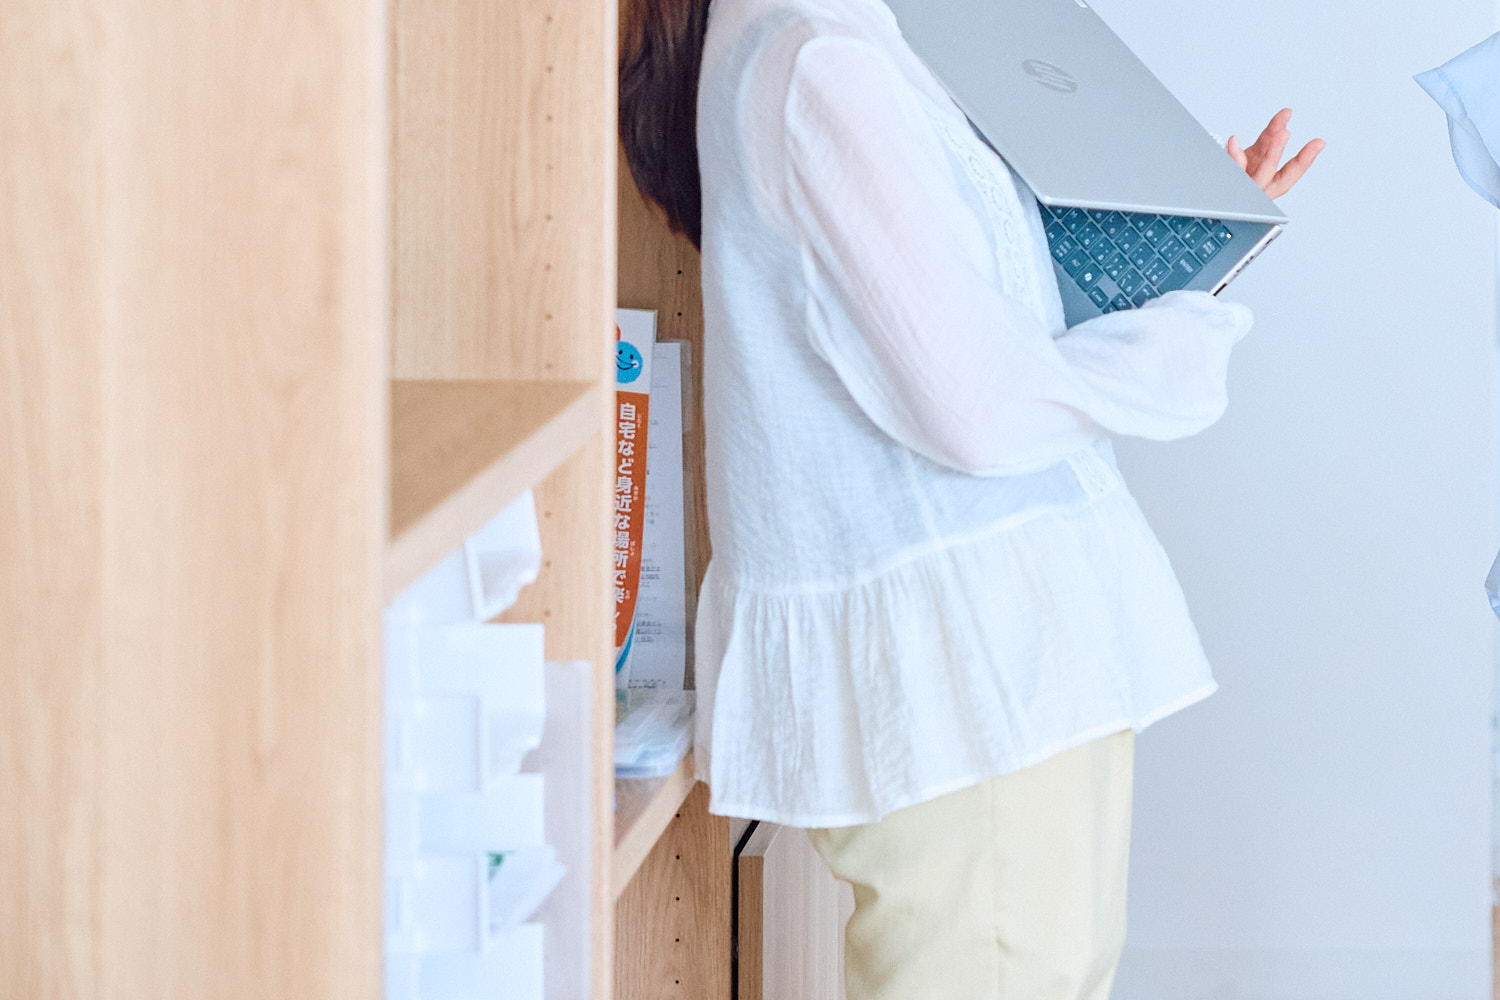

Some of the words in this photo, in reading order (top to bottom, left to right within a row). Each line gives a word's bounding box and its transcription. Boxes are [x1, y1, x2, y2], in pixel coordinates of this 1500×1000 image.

[614, 402, 636, 632] 自宅など身近な場所で楽
